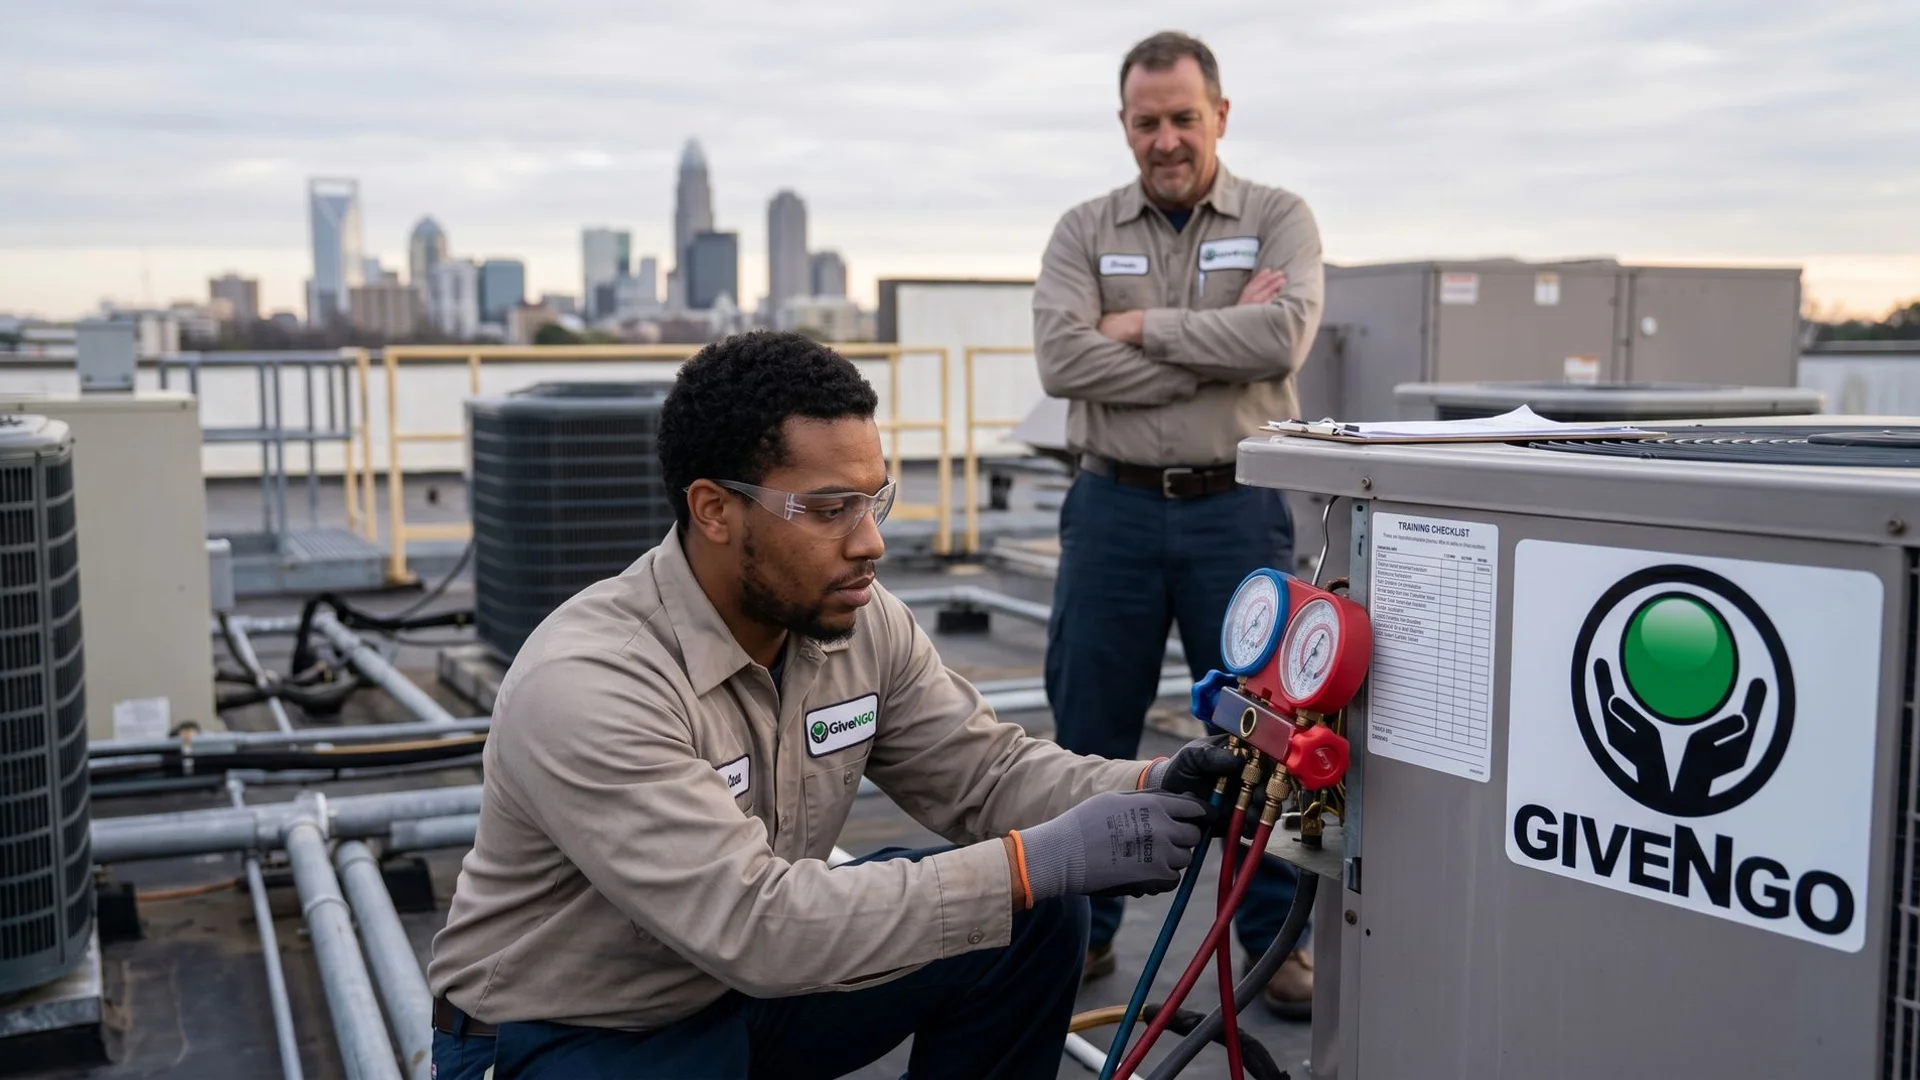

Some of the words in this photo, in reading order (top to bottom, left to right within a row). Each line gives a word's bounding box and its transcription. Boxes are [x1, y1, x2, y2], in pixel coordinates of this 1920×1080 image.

[1398, 521, 1430, 534] TRAINING
[1431, 525, 1470, 538] CHECKLIST
[829, 710, 875, 735] GiveNGO
[1514, 804, 1855, 935] GIVENGO
